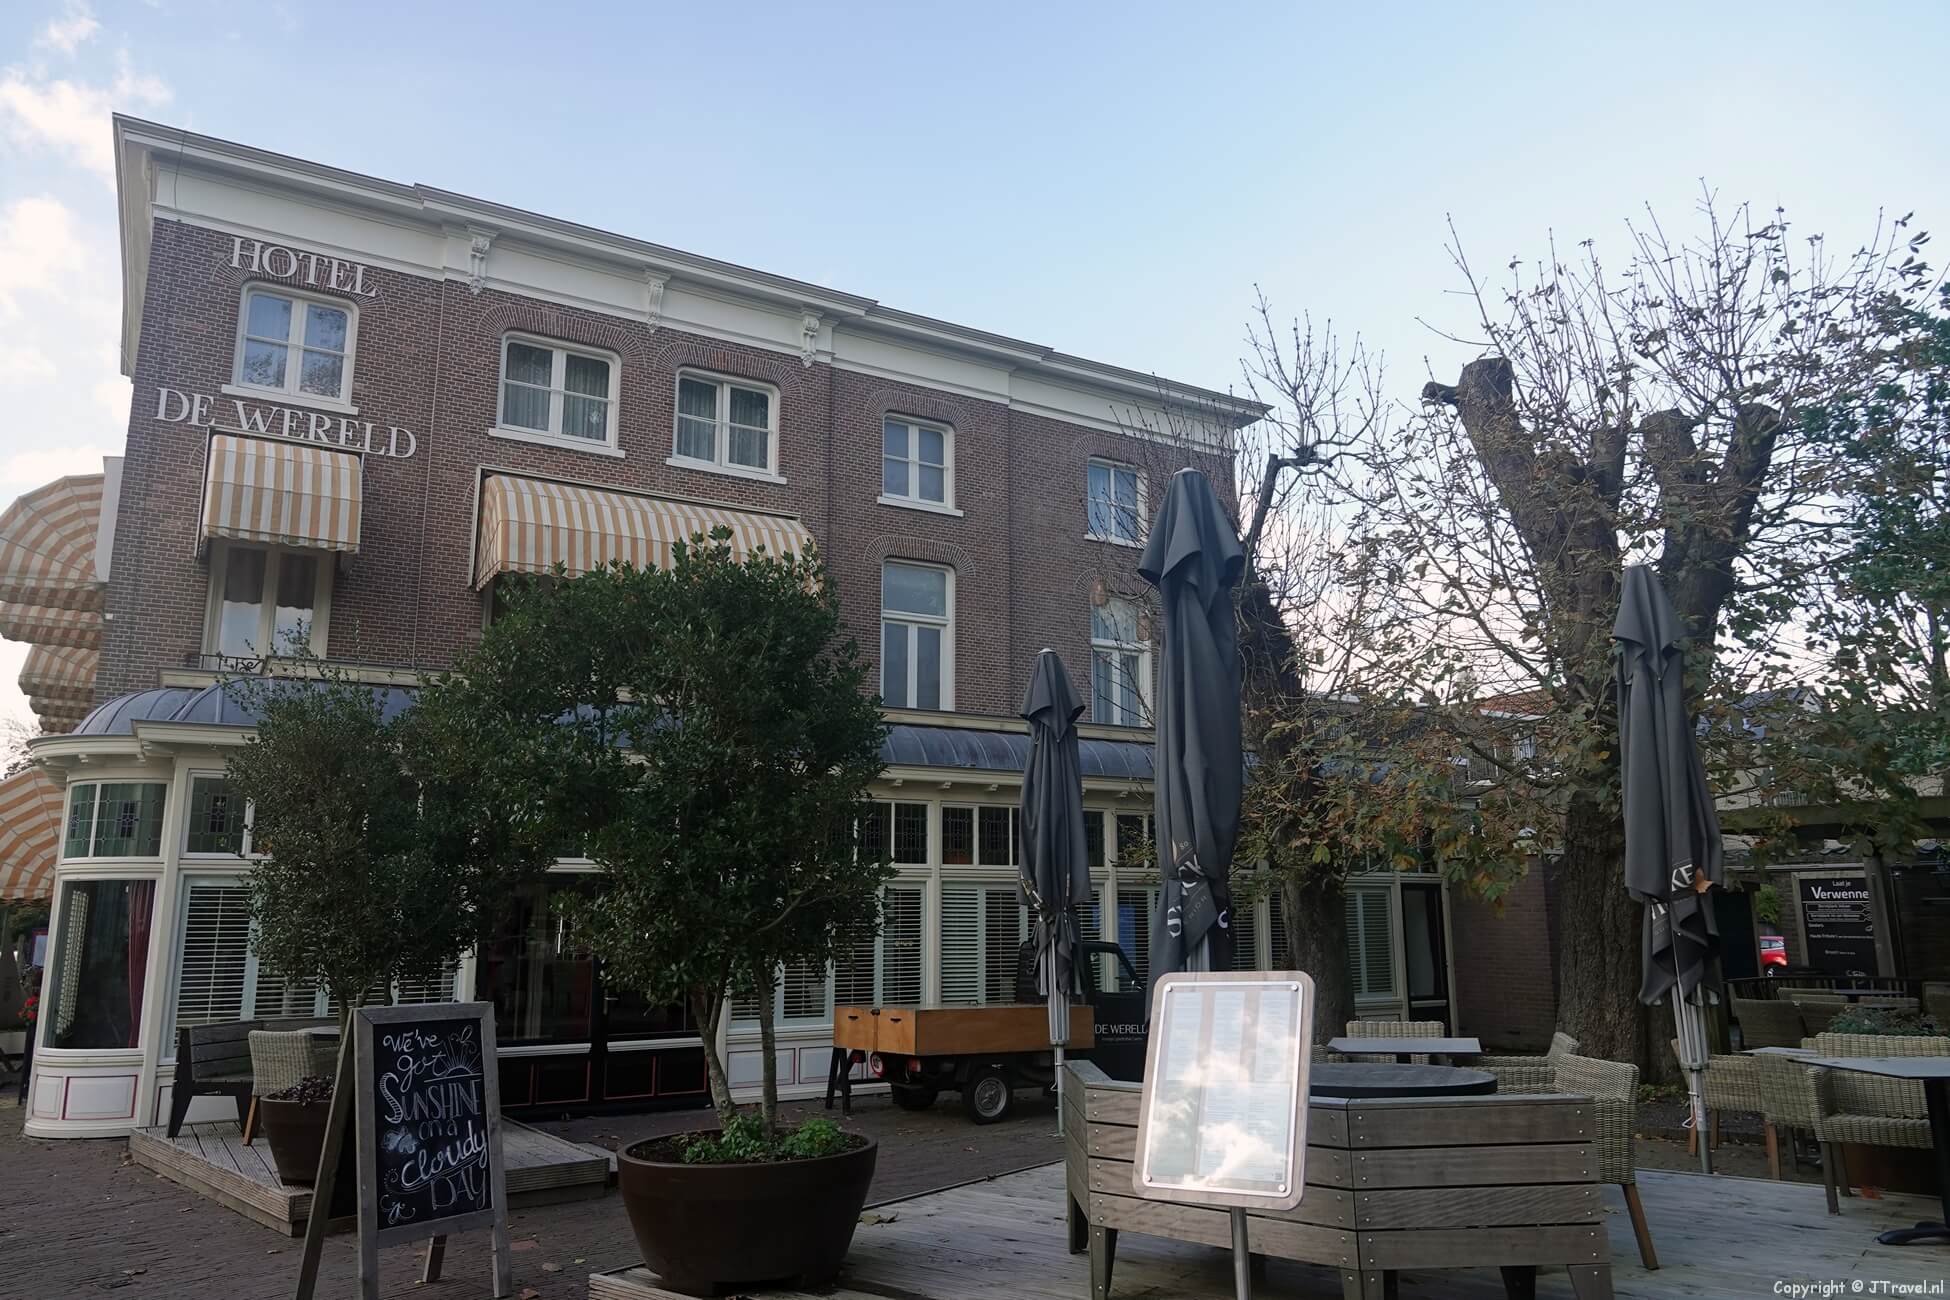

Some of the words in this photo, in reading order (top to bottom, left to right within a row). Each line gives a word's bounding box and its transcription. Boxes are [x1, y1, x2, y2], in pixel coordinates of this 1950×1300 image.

[230, 236, 378, 298] HOTEL
[155, 387, 215, 427] DE
[233, 400, 417, 458] WERELD
[383, 1029, 441, 1053] We've
[1094, 1023, 1109, 1034] DE
[397, 1051, 447, 1092] got
[418, 1120, 441, 1140] on
[447, 1119, 458, 1137] a
